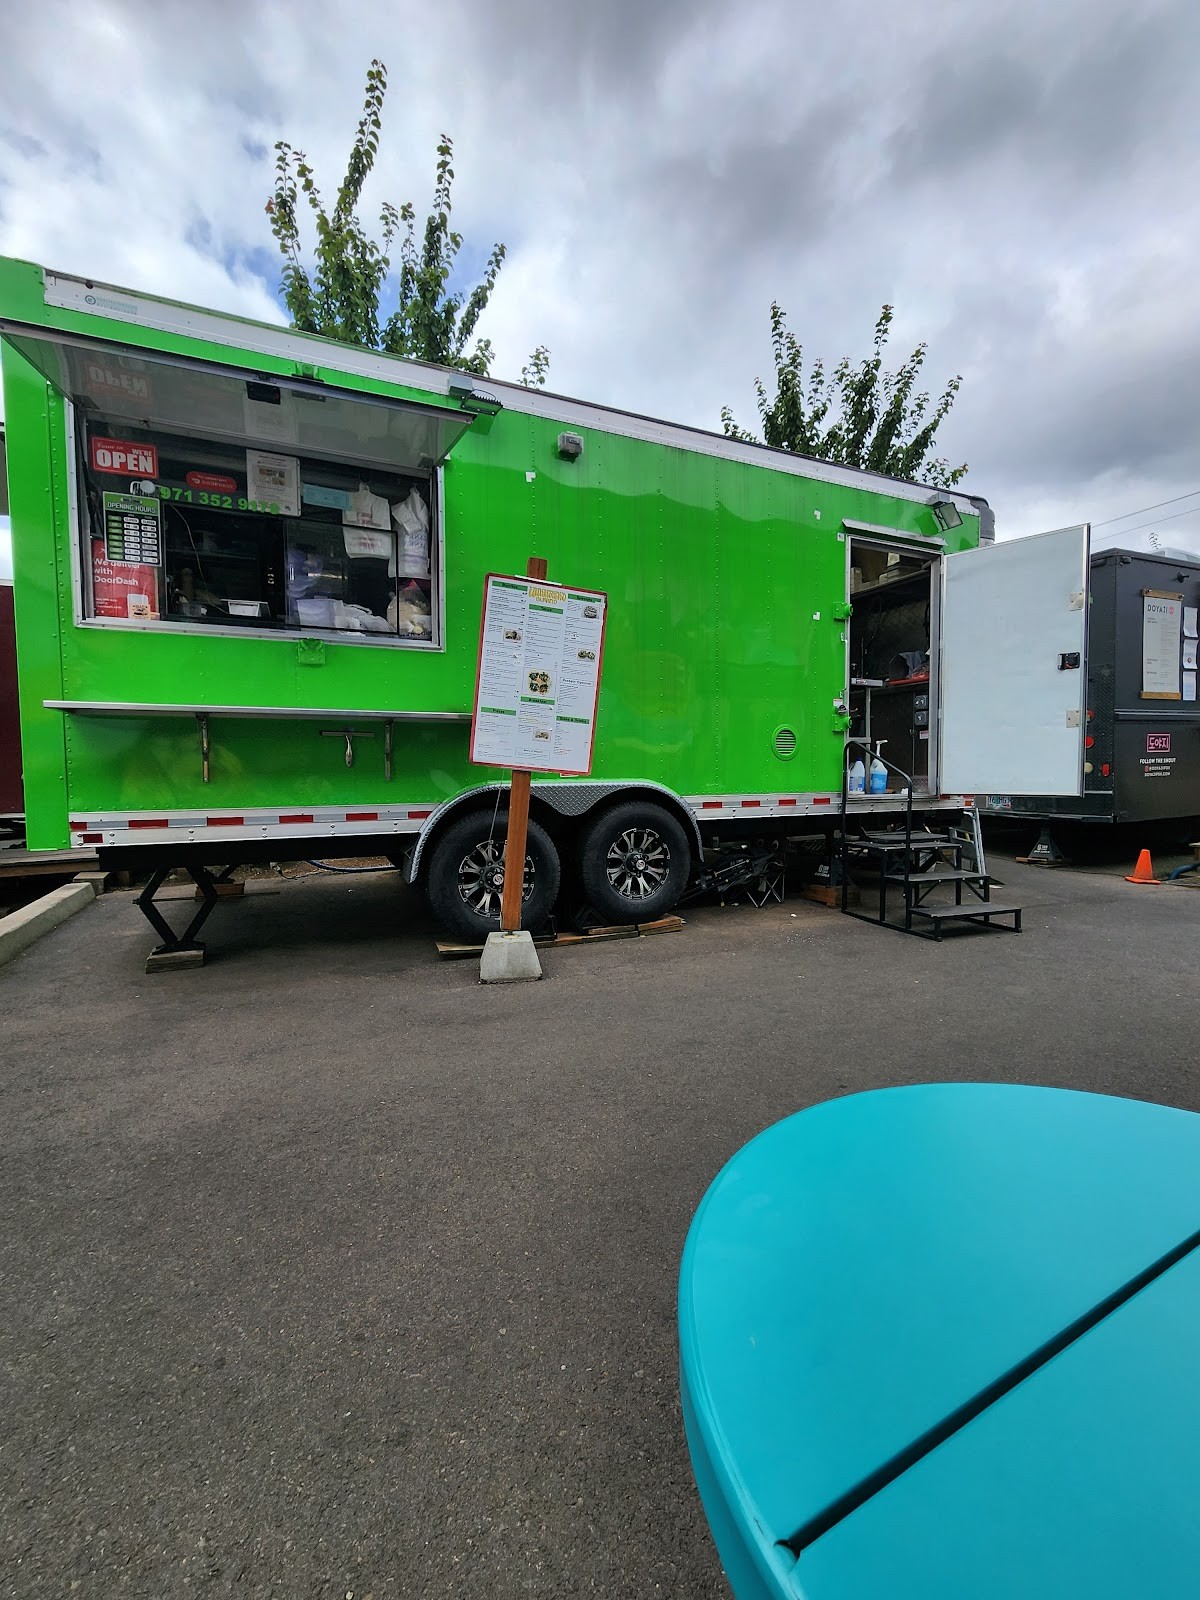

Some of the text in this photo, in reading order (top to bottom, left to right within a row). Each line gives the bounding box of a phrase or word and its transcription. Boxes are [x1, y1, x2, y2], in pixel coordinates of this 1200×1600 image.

[96, 449, 153, 473] OPEN
[160, 487, 192, 502] 971
[199, 492, 232, 509] 352
[107, 502, 156, 515] OPENING HOURS
[94, 576, 138, 586] DoorDash
[1147, 604, 1168, 614] DOYAJI
[1148, 737, 1169, 749] 도야지
